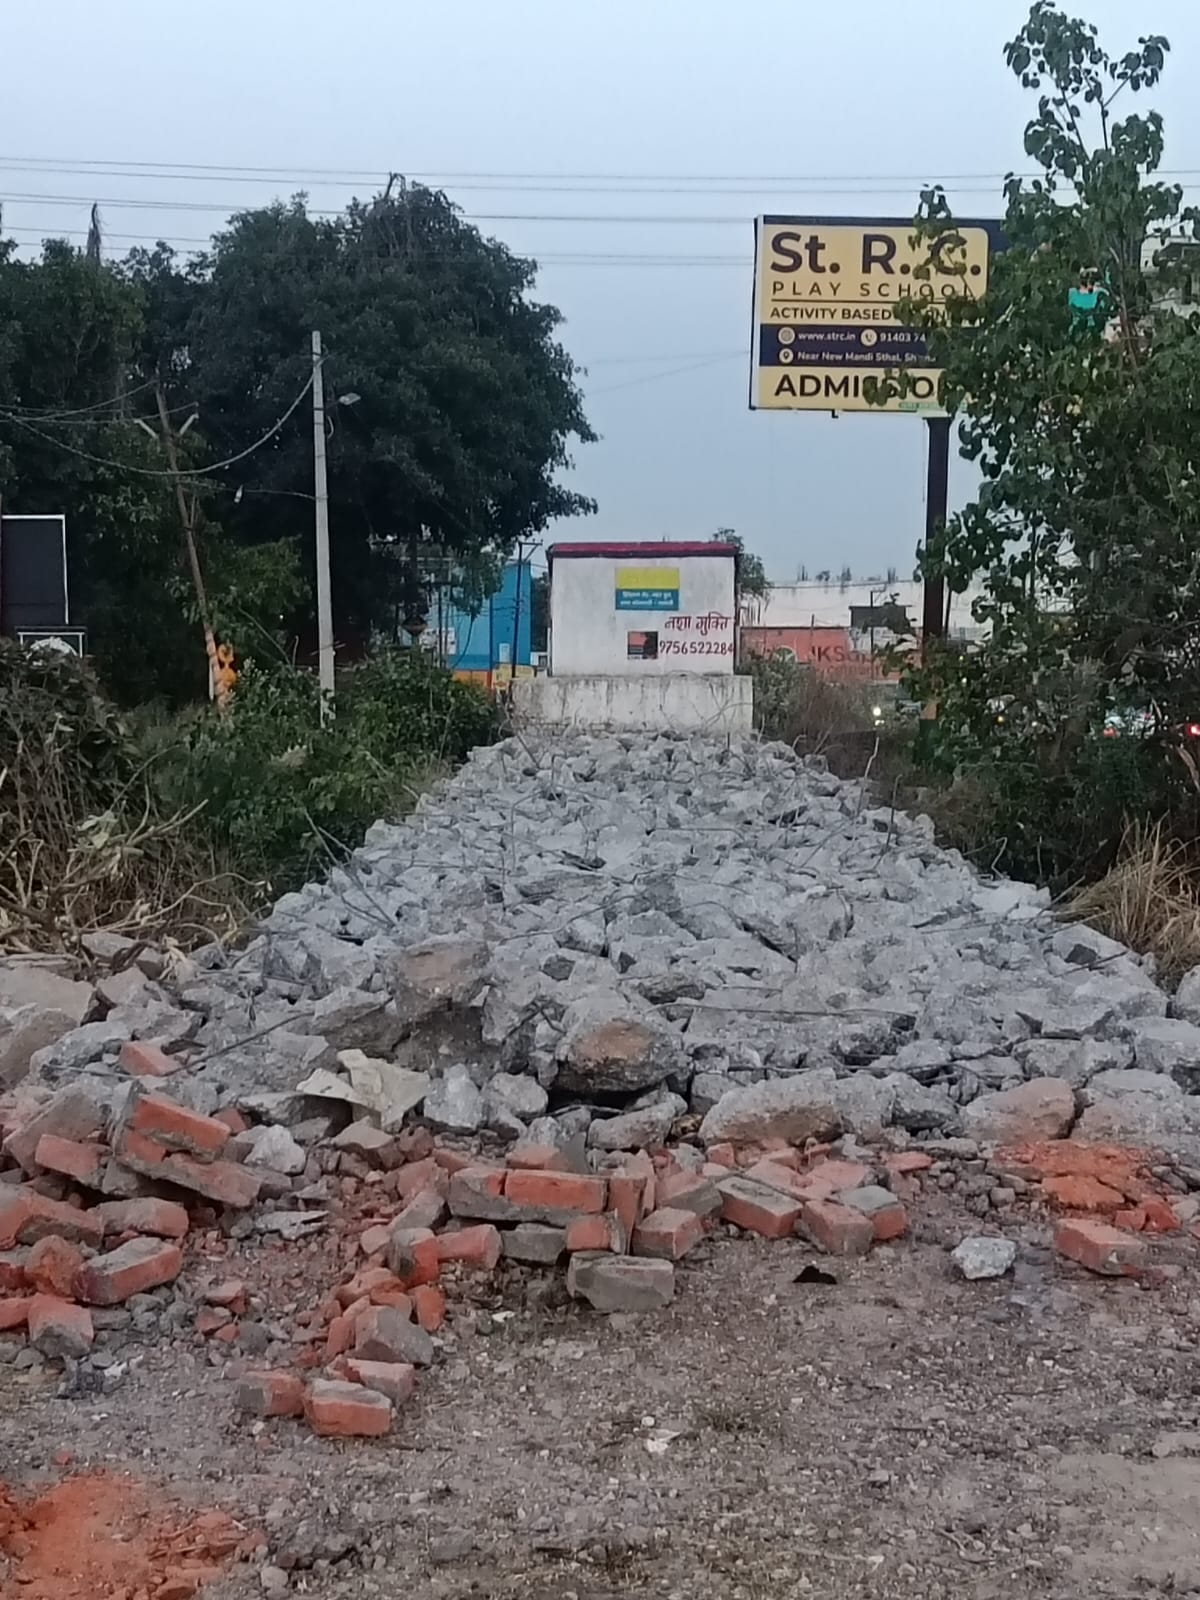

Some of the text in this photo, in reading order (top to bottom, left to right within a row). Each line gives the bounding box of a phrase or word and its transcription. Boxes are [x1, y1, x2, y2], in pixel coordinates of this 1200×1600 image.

[770, 231, 841, 274] St.
[862, 233, 911, 275] R.
[772, 281, 842, 297] PLAY
[770, 307, 837, 320] ACTIVITY
[841, 308, 892, 321] BASED
[797, 351, 819, 361] Near
[822, 351, 843, 361] New
[845, 351, 874, 361] Mandi
[659, 640, 734, 656] 9756522284
